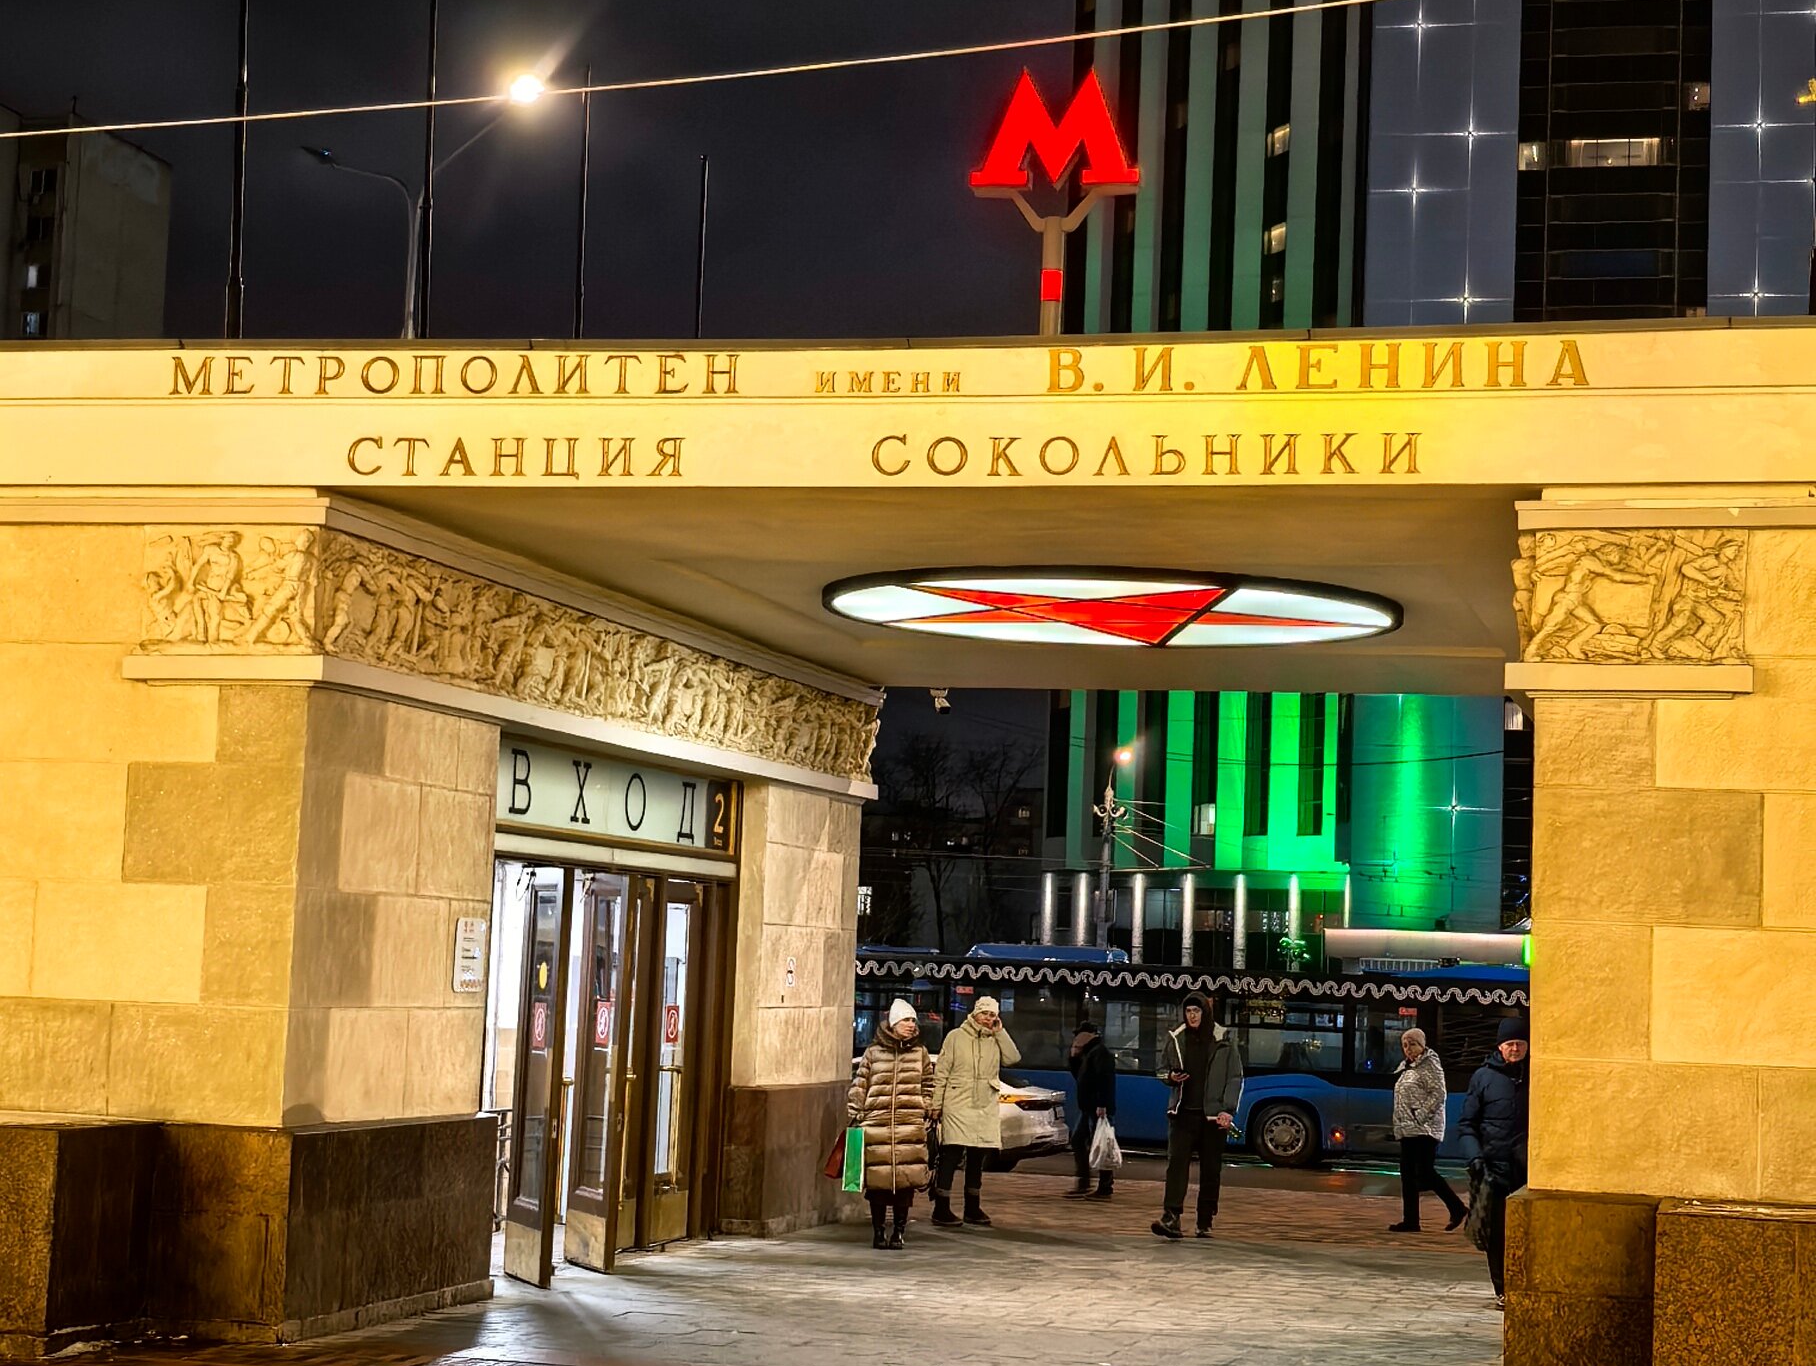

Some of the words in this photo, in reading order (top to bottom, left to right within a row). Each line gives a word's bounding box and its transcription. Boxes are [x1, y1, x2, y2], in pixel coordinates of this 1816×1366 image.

[969, 68, 1140, 187] М
[168, 353, 742, 396] МЕТРОПОЛИТЕН
[813, 370, 962, 395] ИМЕНИ
[1046, 347, 1104, 393] В.
[1132, 345, 1196, 393] И.
[1235, 338, 1591, 391] ЛЕНИНА
[346, 435, 687, 481] СТАНЦИЯ
[871, 432, 1423, 478] СОКОЛЬНИКИ
[508, 749, 697, 845] ВХОД
[713, 792, 725, 834] 2
